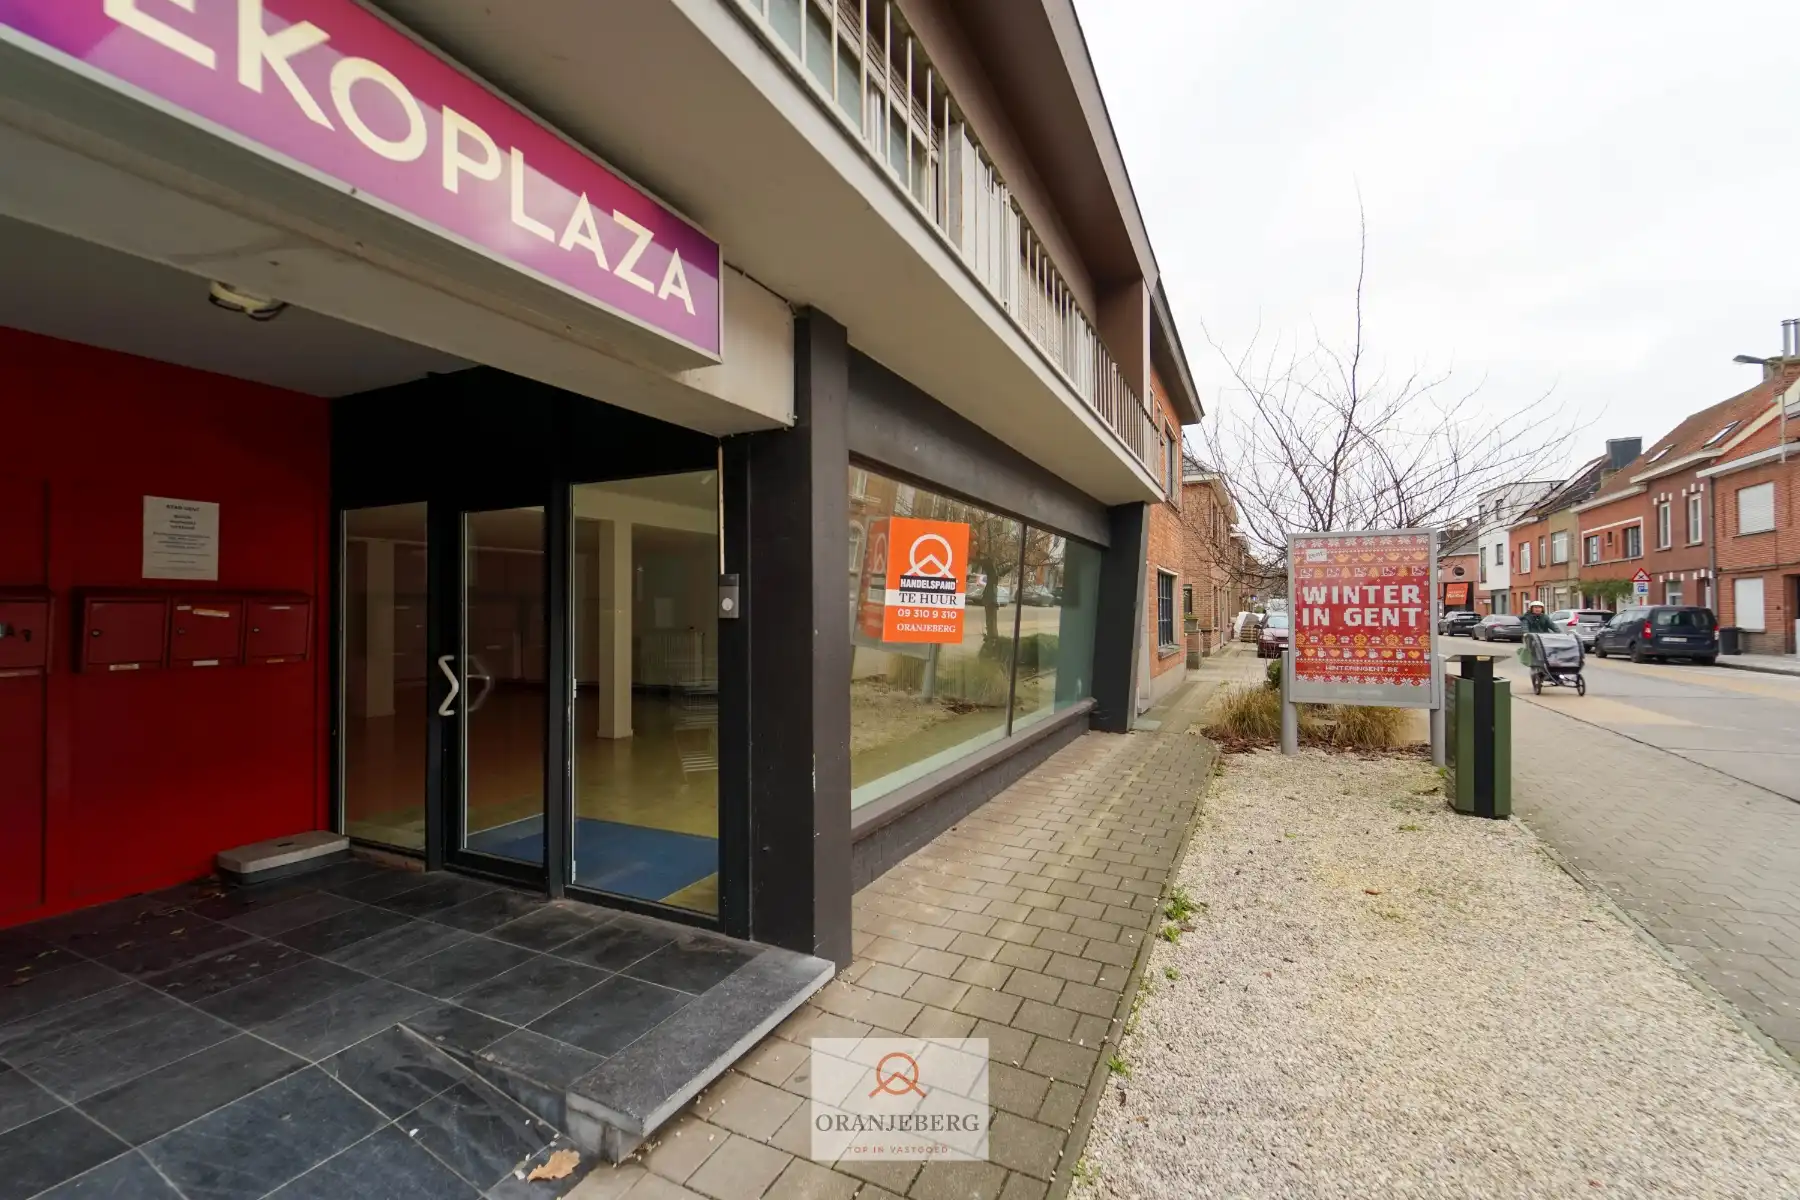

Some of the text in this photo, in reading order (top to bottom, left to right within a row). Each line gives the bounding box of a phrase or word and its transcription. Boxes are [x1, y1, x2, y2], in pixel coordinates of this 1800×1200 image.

[900, 578, 956, 591] HANDELSPAND
[899, 592, 958, 605] TE HUUR
[1302, 584, 1422, 605] WINTER
[897, 608, 957, 619] 09 310 9 310
[1302, 607, 1422, 627] IN GENT
[897, 622, 956, 633] ORANJEBERG
